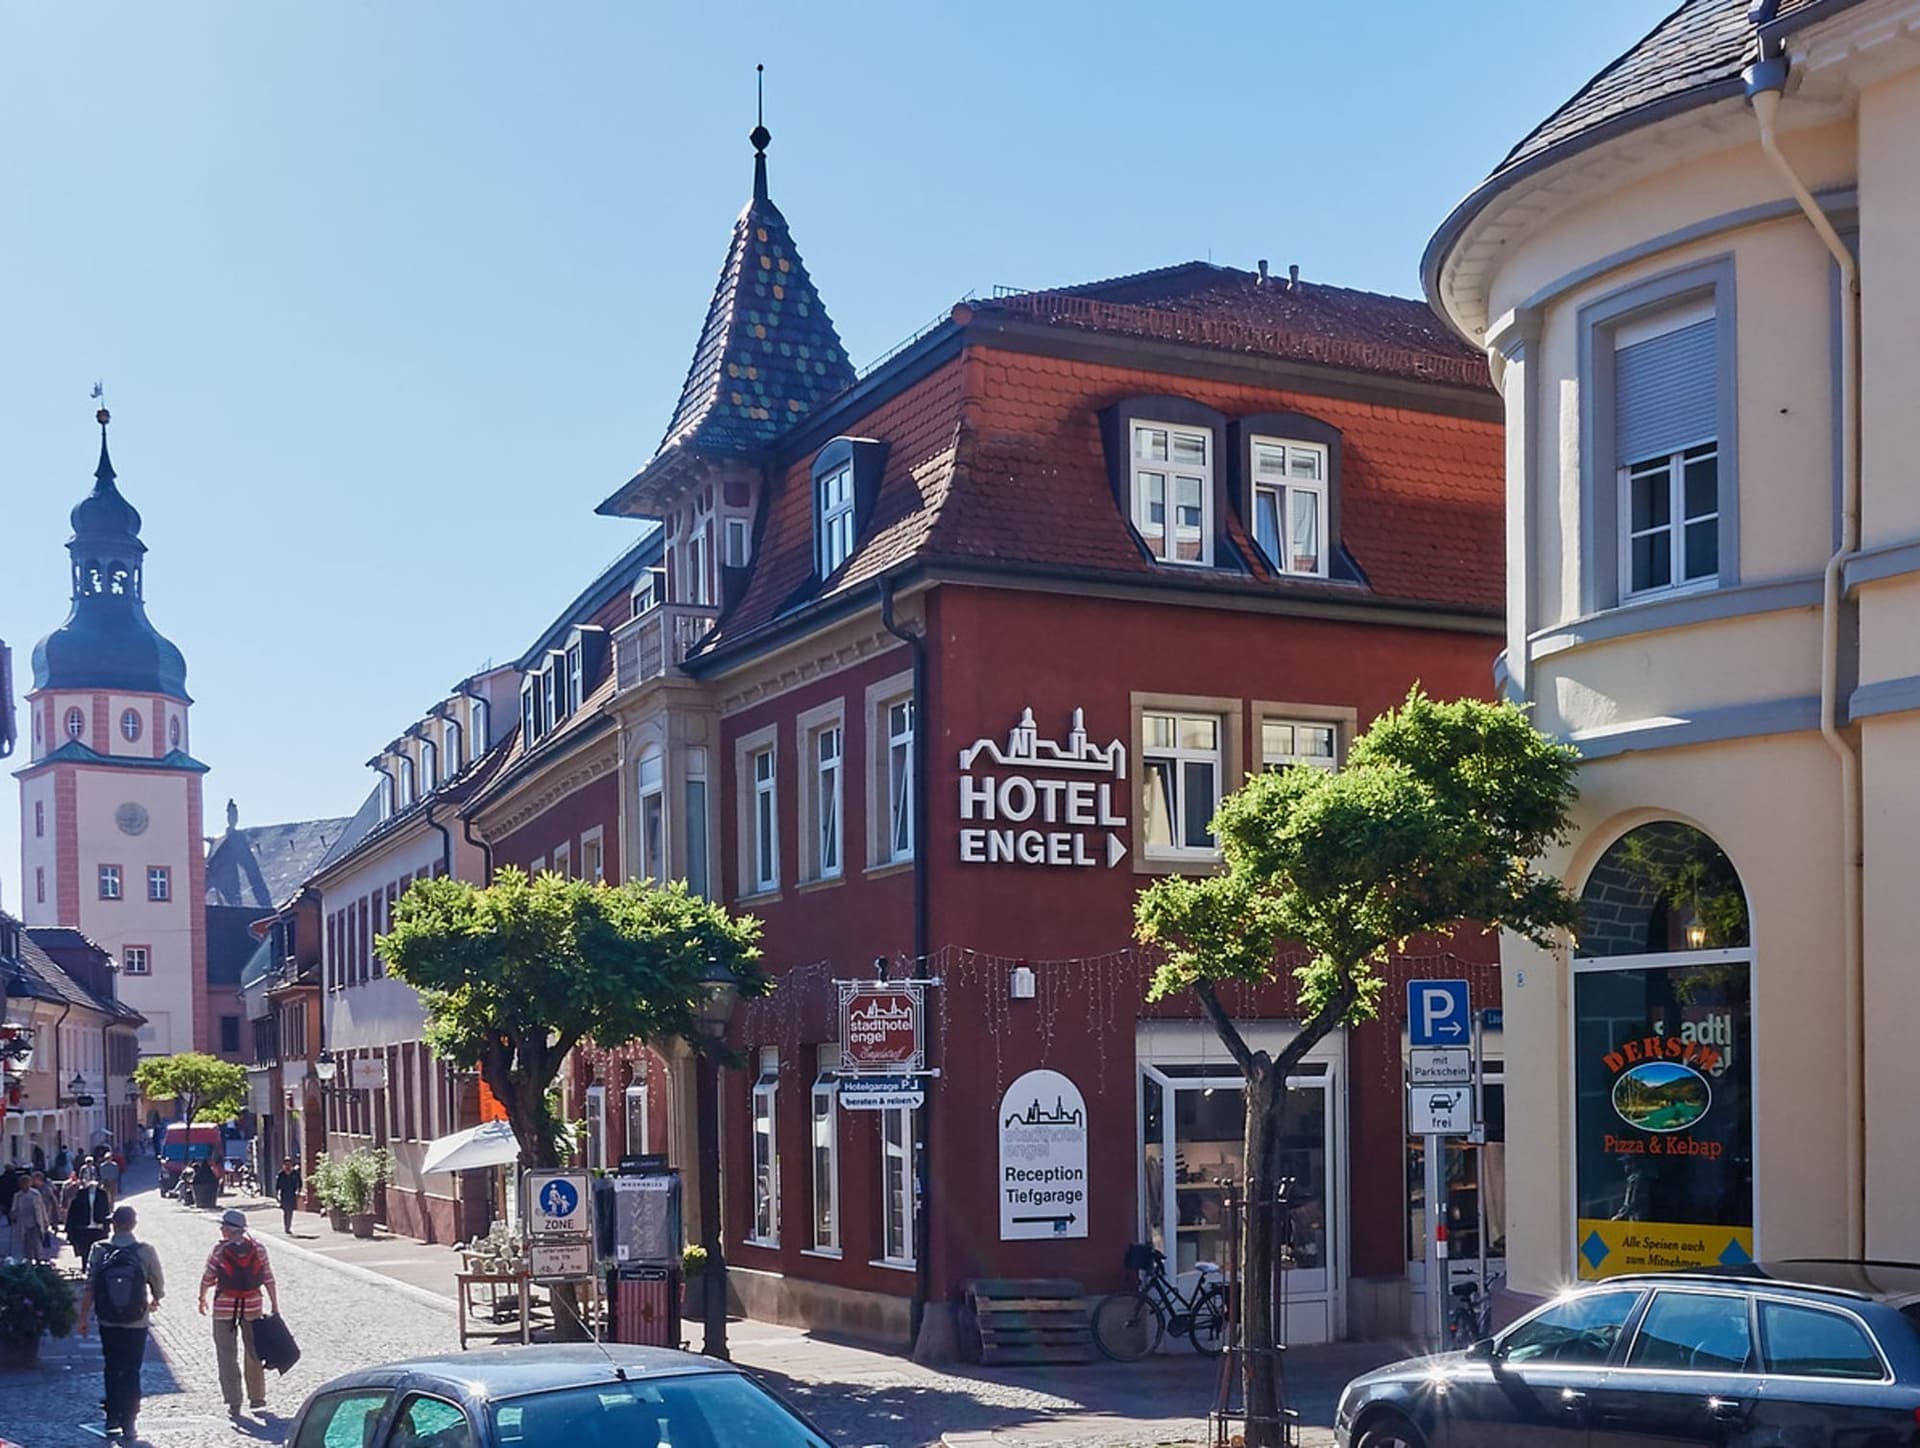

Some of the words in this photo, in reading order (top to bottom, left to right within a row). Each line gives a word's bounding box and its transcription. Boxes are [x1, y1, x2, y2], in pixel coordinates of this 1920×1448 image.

[960, 775, 1127, 826] HOTEL
[960, 829, 1096, 868] ENGEL
[1422, 989, 1455, 1038] P
[850, 1018, 913, 1032] stadthotel
[850, 1031, 886, 1045] engel
[1432, 1056, 1448, 1065] mit
[1414, 1066, 1467, 1077] Parkschein
[1431, 1117, 1452, 1128] frei
[1604, 1135, 1645, 1153] Pizza
[1649, 1137, 1661, 1154] &
[1666, 1136, 1723, 1160] Kebap
[1005, 1166, 1083, 1183] Reception
[1006, 1188, 1083, 1206] Tiefgarage
[545, 1219, 574, 1229] ZONE
[1622, 1236, 1641, 1248] Alle
[1643, 1236, 1679, 1251] Speisen
[1681, 1240, 1705, 1252] auch
[1625, 1255, 1645, 1265] zum
